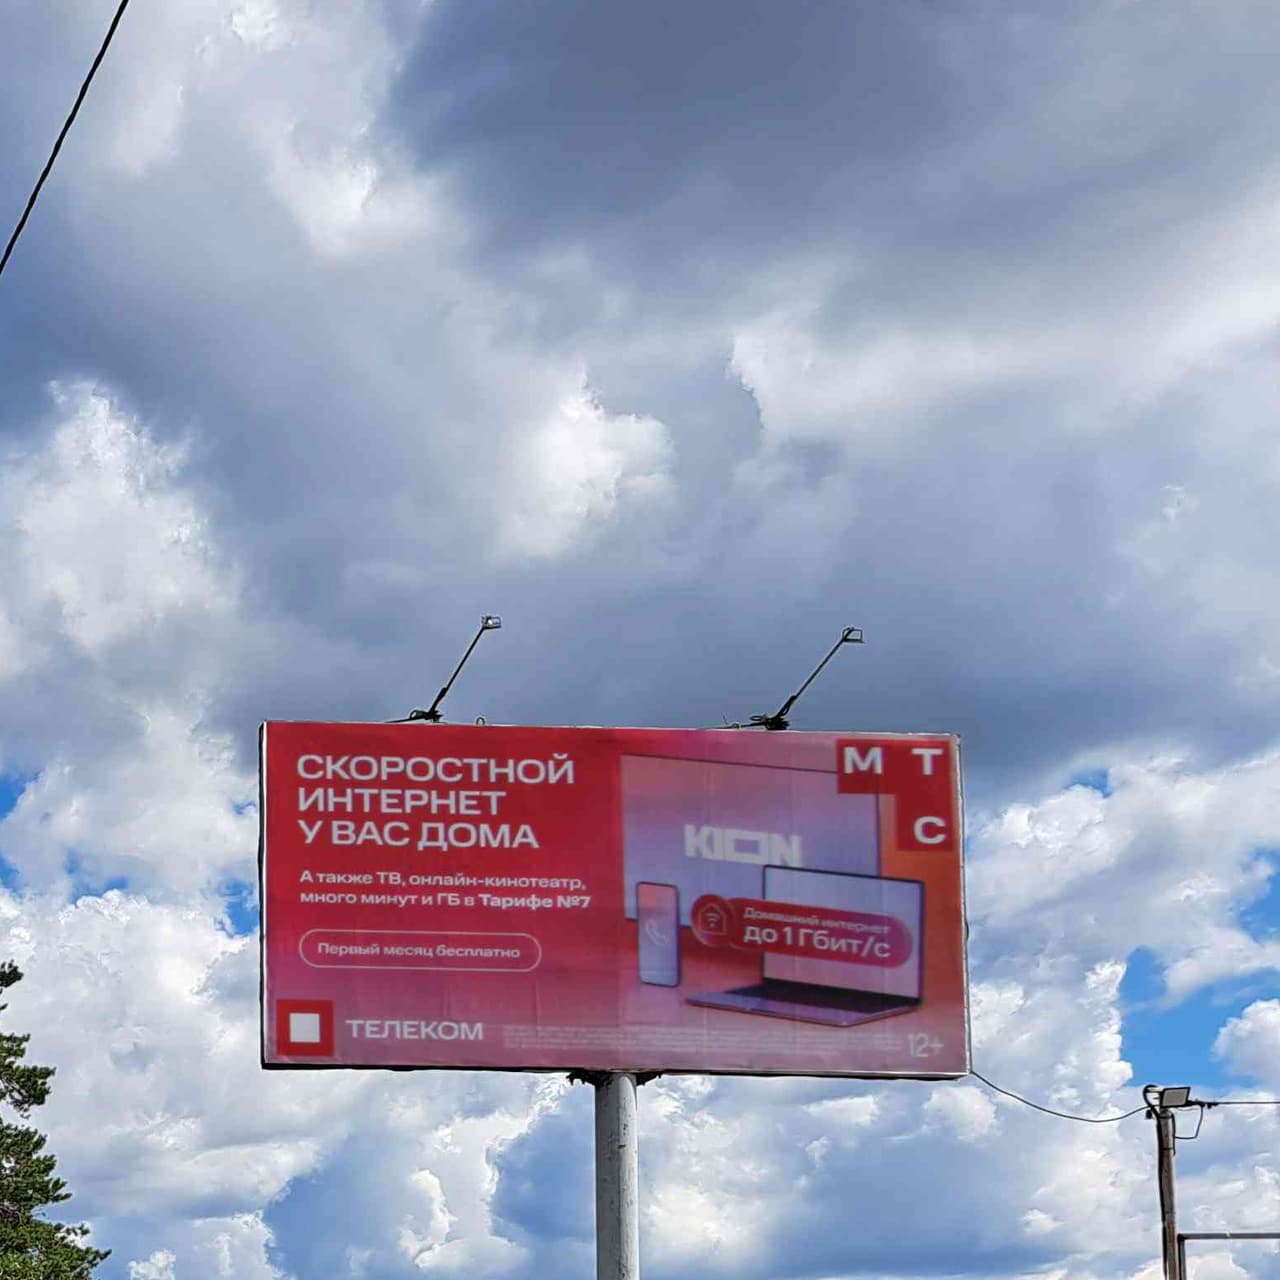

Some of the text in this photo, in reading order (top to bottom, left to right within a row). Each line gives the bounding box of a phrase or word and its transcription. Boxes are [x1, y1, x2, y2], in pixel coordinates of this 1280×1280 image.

[297, 753, 575, 784] СКОРОСТНОЙ
[298, 787, 507, 815] ИНТЕРНЕТ
[297, 820, 540, 851] У ВАС ДОМА
[684, 824, 803, 867] KION
[300, 870, 587, 890] А также ТВ, онлайн-кинотеатр,
[300, 892, 591, 910] много минут и ГБ в Тарифе №7
[743, 907, 889, 935] Домашний интернет
[318, 942, 521, 959] Первый месяц бесплатно
[743, 926, 891, 957] до 1 Гбит/с
[345, 1020, 483, 1040] ТЕЛЕКОМ
[907, 1033, 945, 1057] 12+
